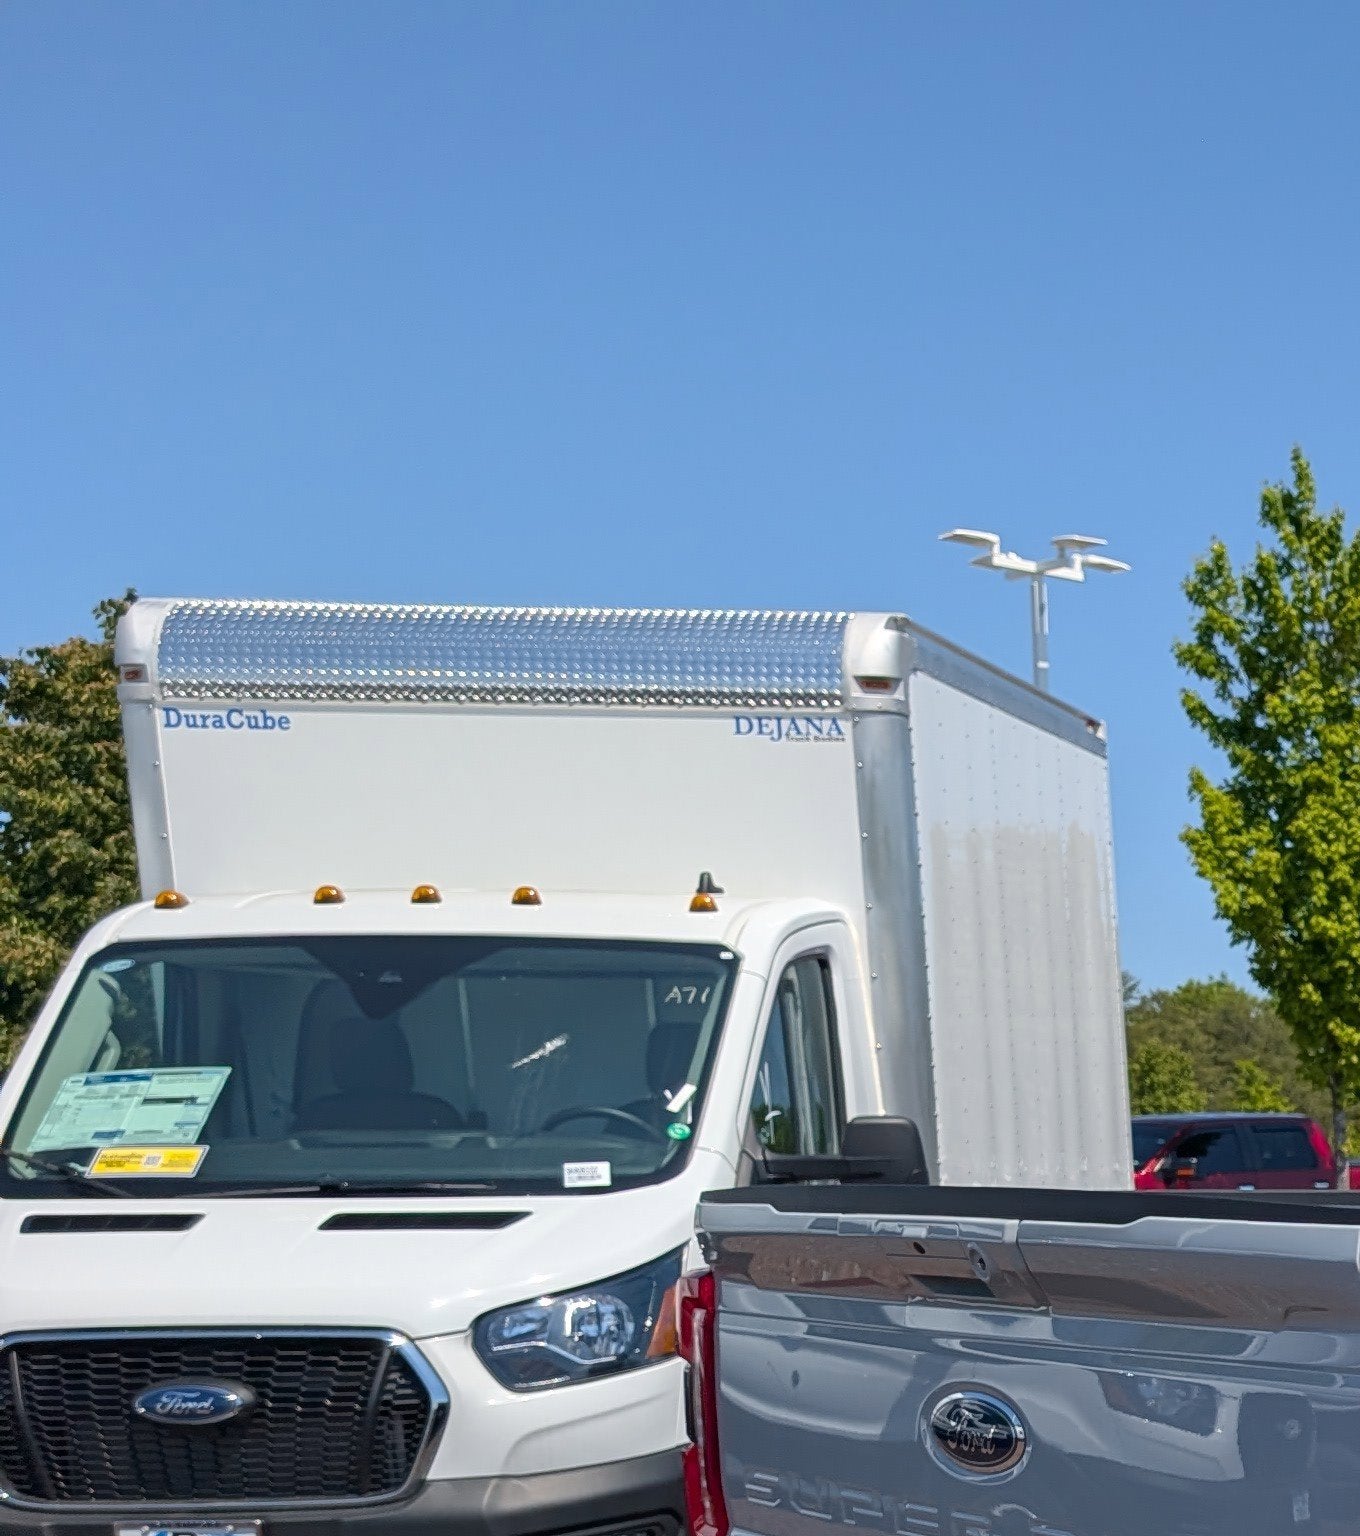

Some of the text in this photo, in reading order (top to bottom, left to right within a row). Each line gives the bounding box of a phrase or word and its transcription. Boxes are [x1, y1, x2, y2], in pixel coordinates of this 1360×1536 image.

[163, 706, 291, 730] DuraCube
[733, 716, 845, 742] DEJANA
[156, 1390, 215, 1416] Ford
